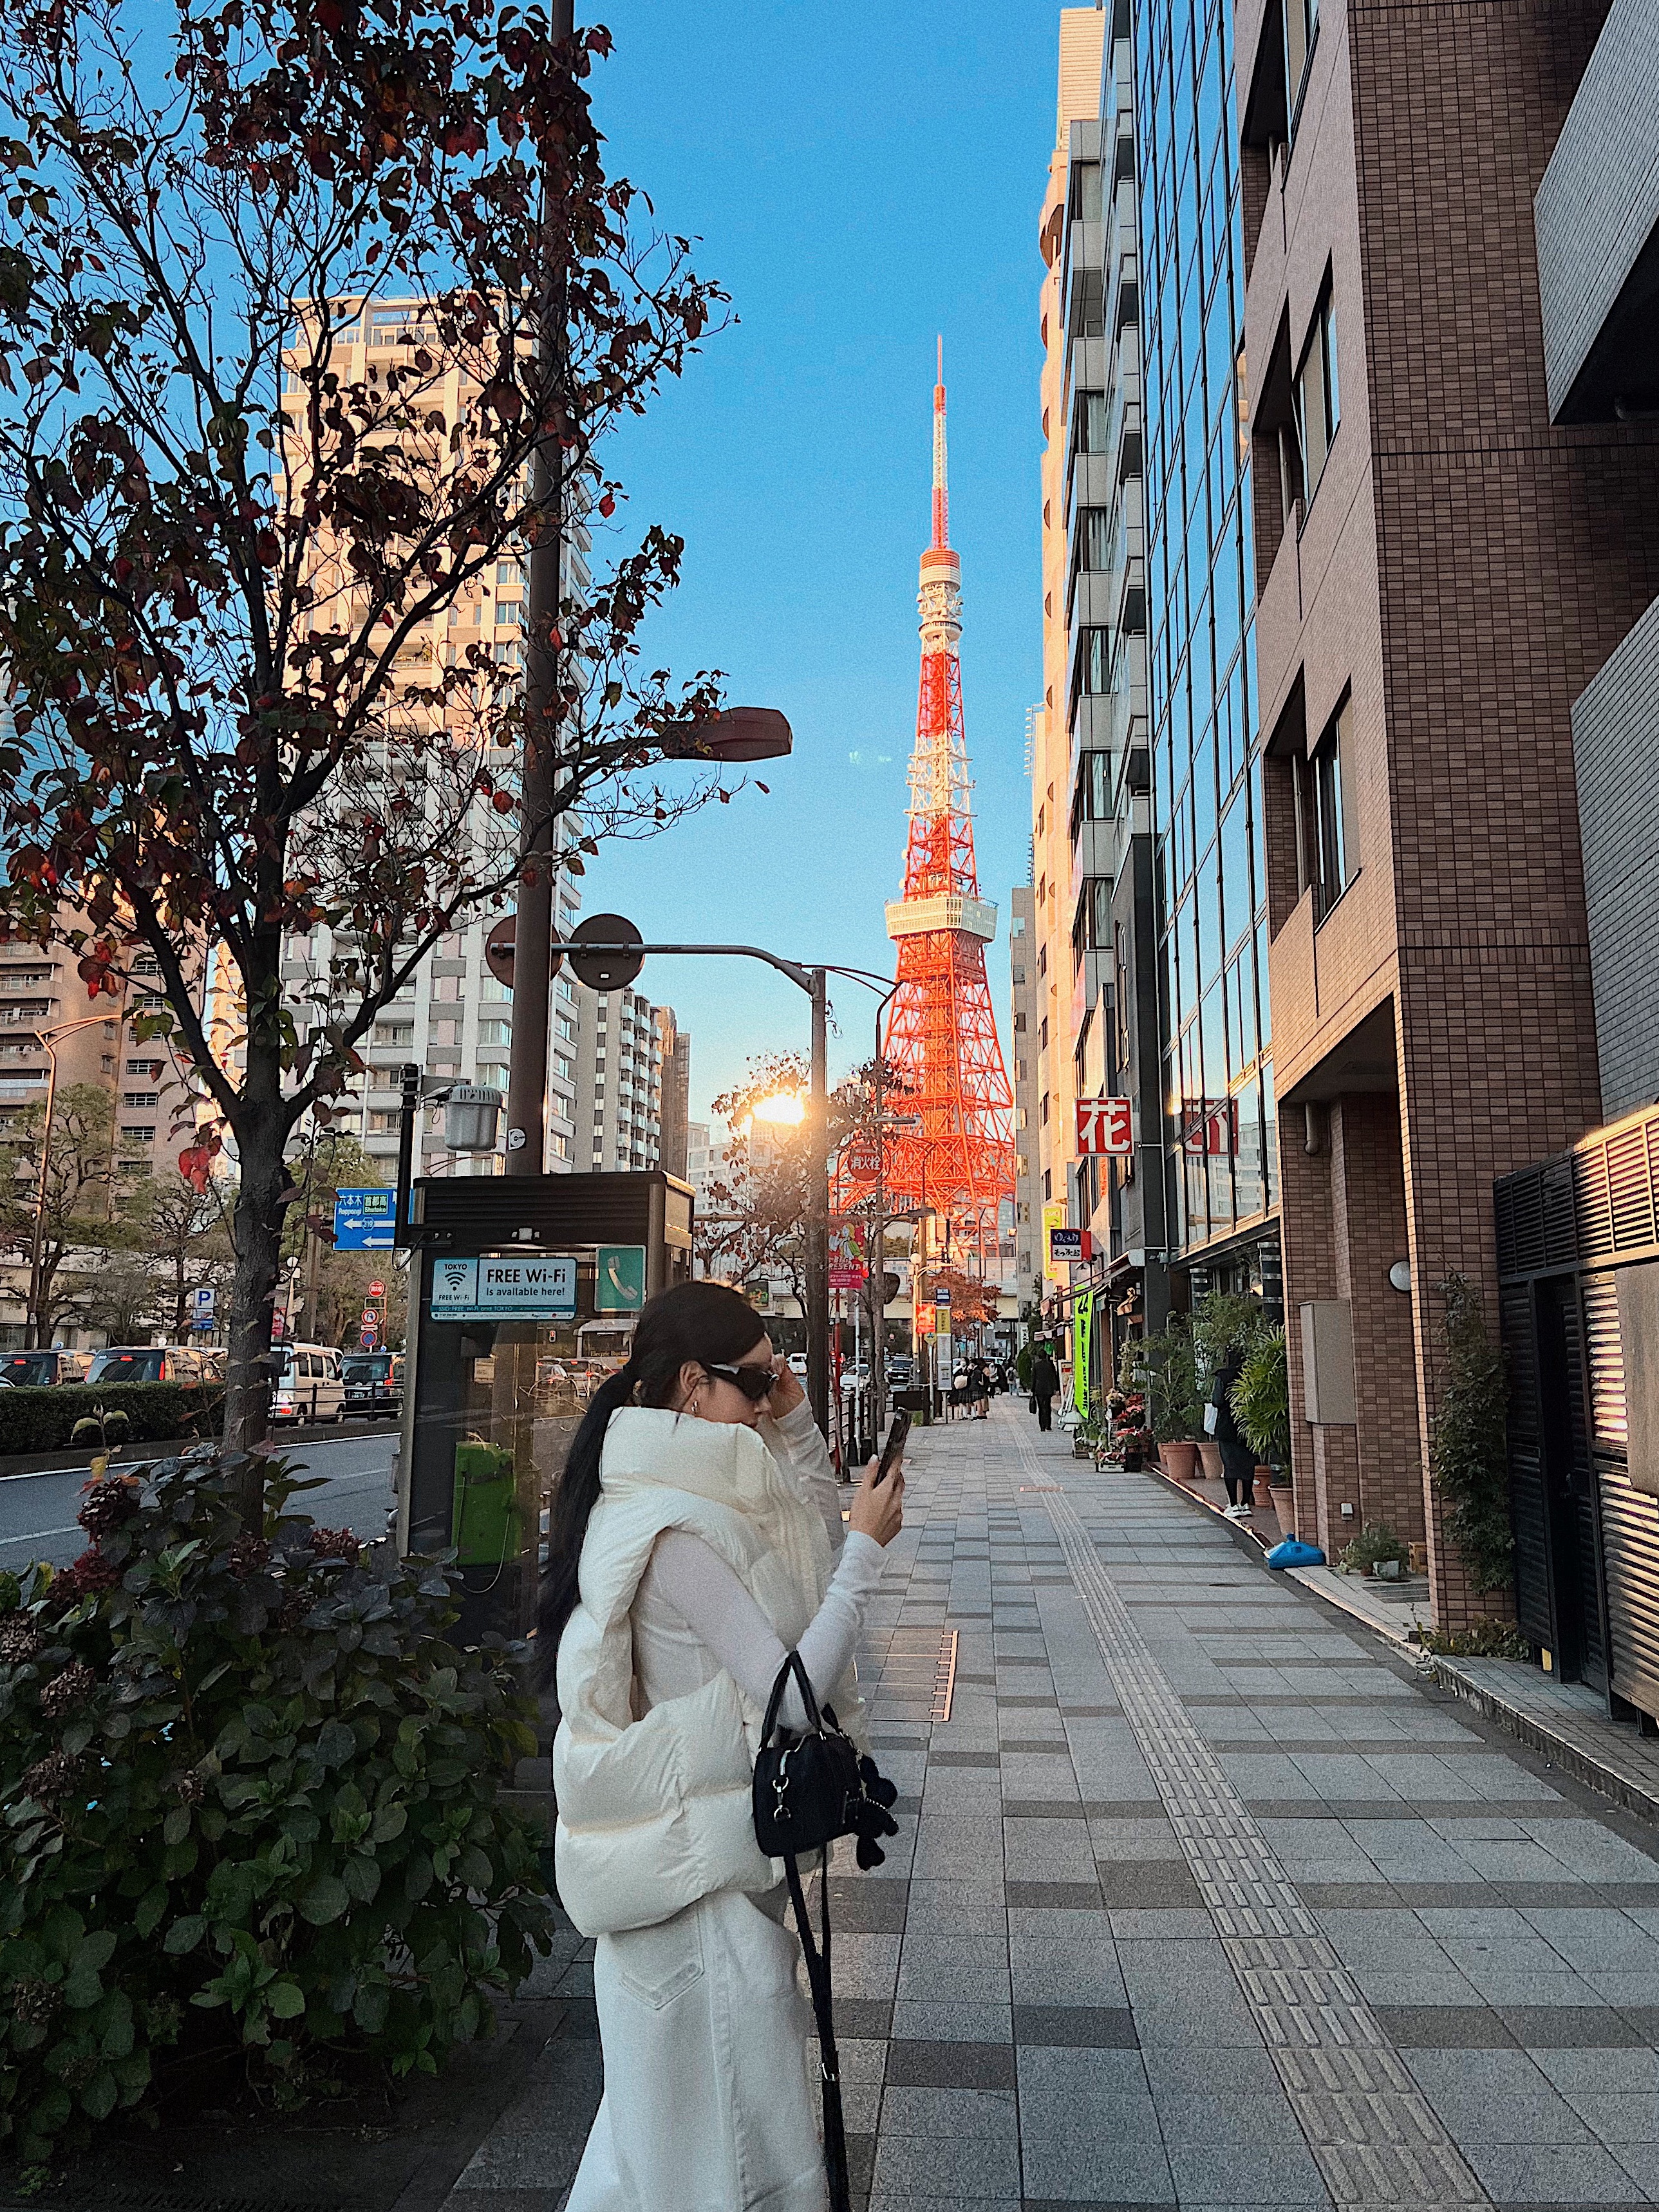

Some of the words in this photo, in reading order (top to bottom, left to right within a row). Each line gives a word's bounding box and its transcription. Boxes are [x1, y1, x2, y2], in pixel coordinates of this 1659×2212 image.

[1079, 1100, 1131, 1152] 花
[850, 1155, 881, 1170] 消火栓
[338, 1194, 362, 1206] 六本木
[364, 1195, 388, 1206] 首都高
[828, 1261, 861, 1271] RESENT
[487, 1268, 521, 1283] FREE
[526, 1268, 566, 1283] Wi-Fi
[198, 1290, 211, 1306] P
[496, 1288, 538, 1296] available
[541, 1288, 565, 1296] here!
